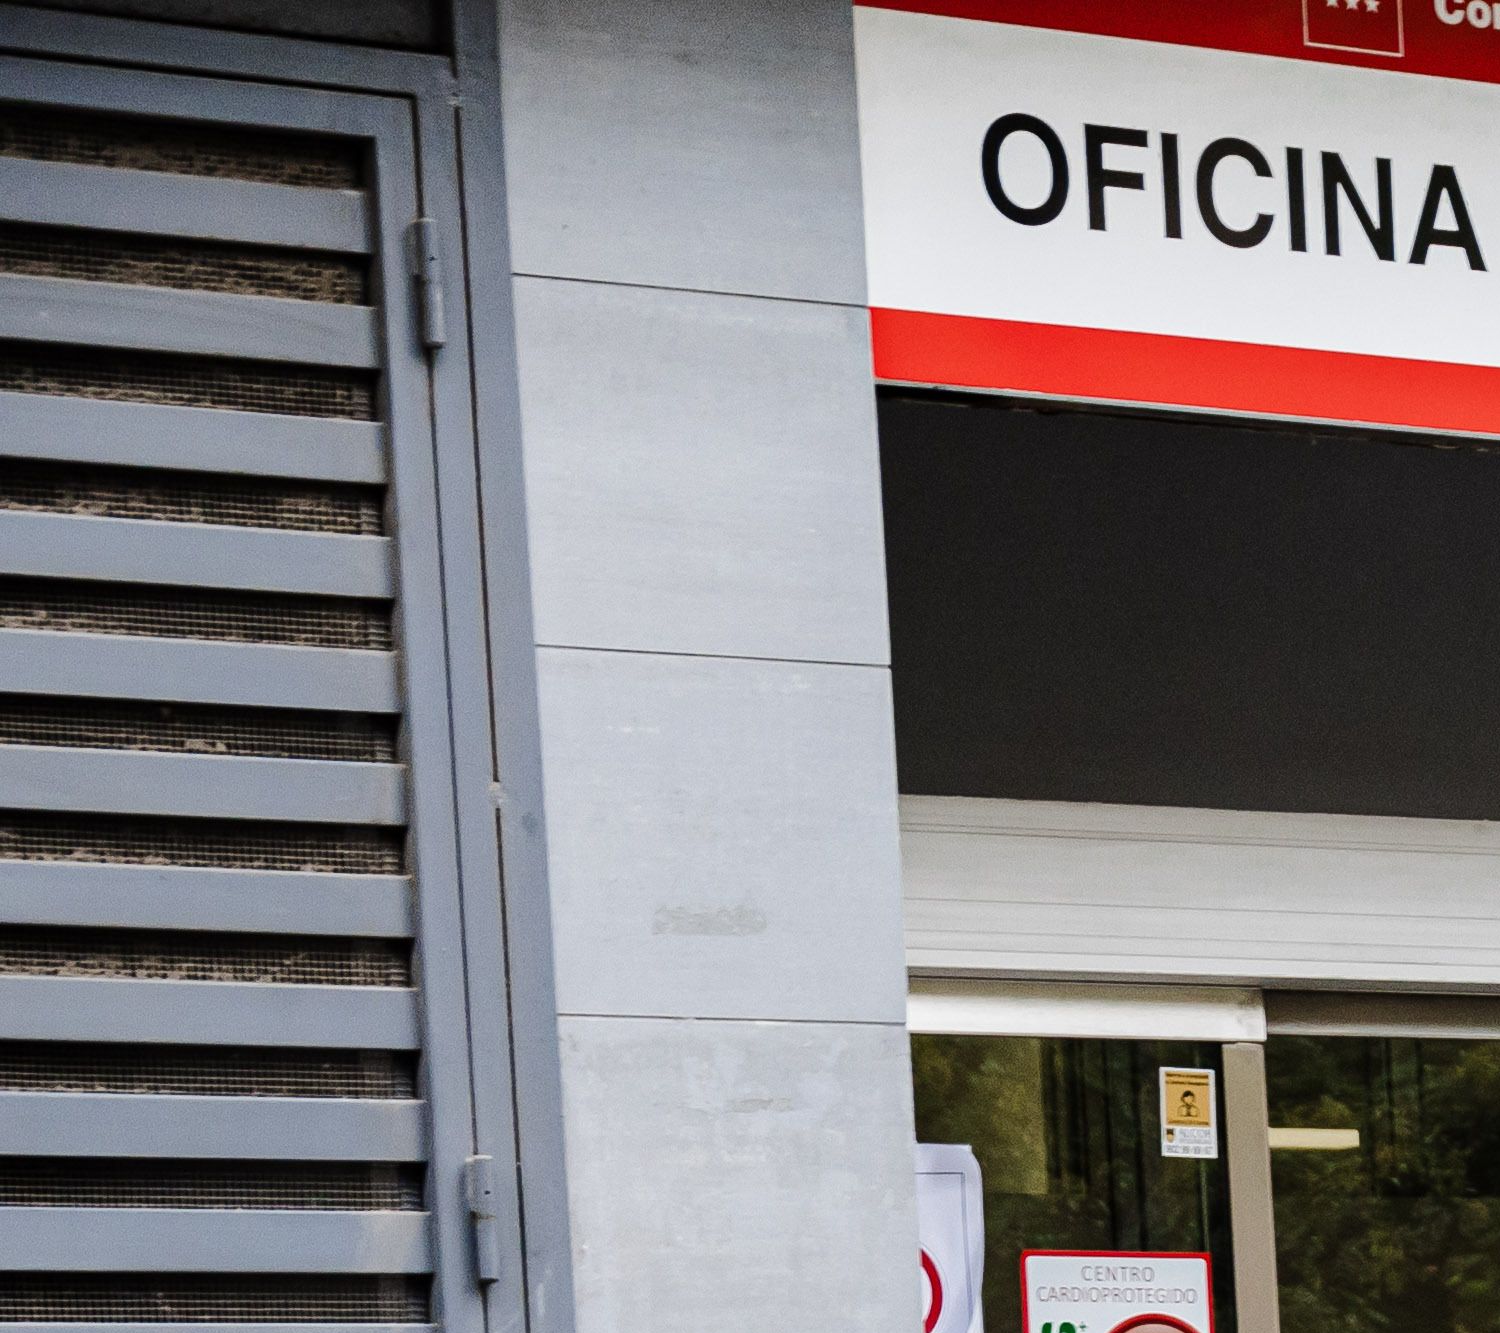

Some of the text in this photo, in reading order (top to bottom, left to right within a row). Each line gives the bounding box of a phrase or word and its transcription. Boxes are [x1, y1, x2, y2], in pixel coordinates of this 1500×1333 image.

[981, 111, 1488, 272] OFICINA
[1081, 1265, 1155, 1282] CENTRO
[1036, 1286, 1198, 1304] CARDIOPROTEGIDO
